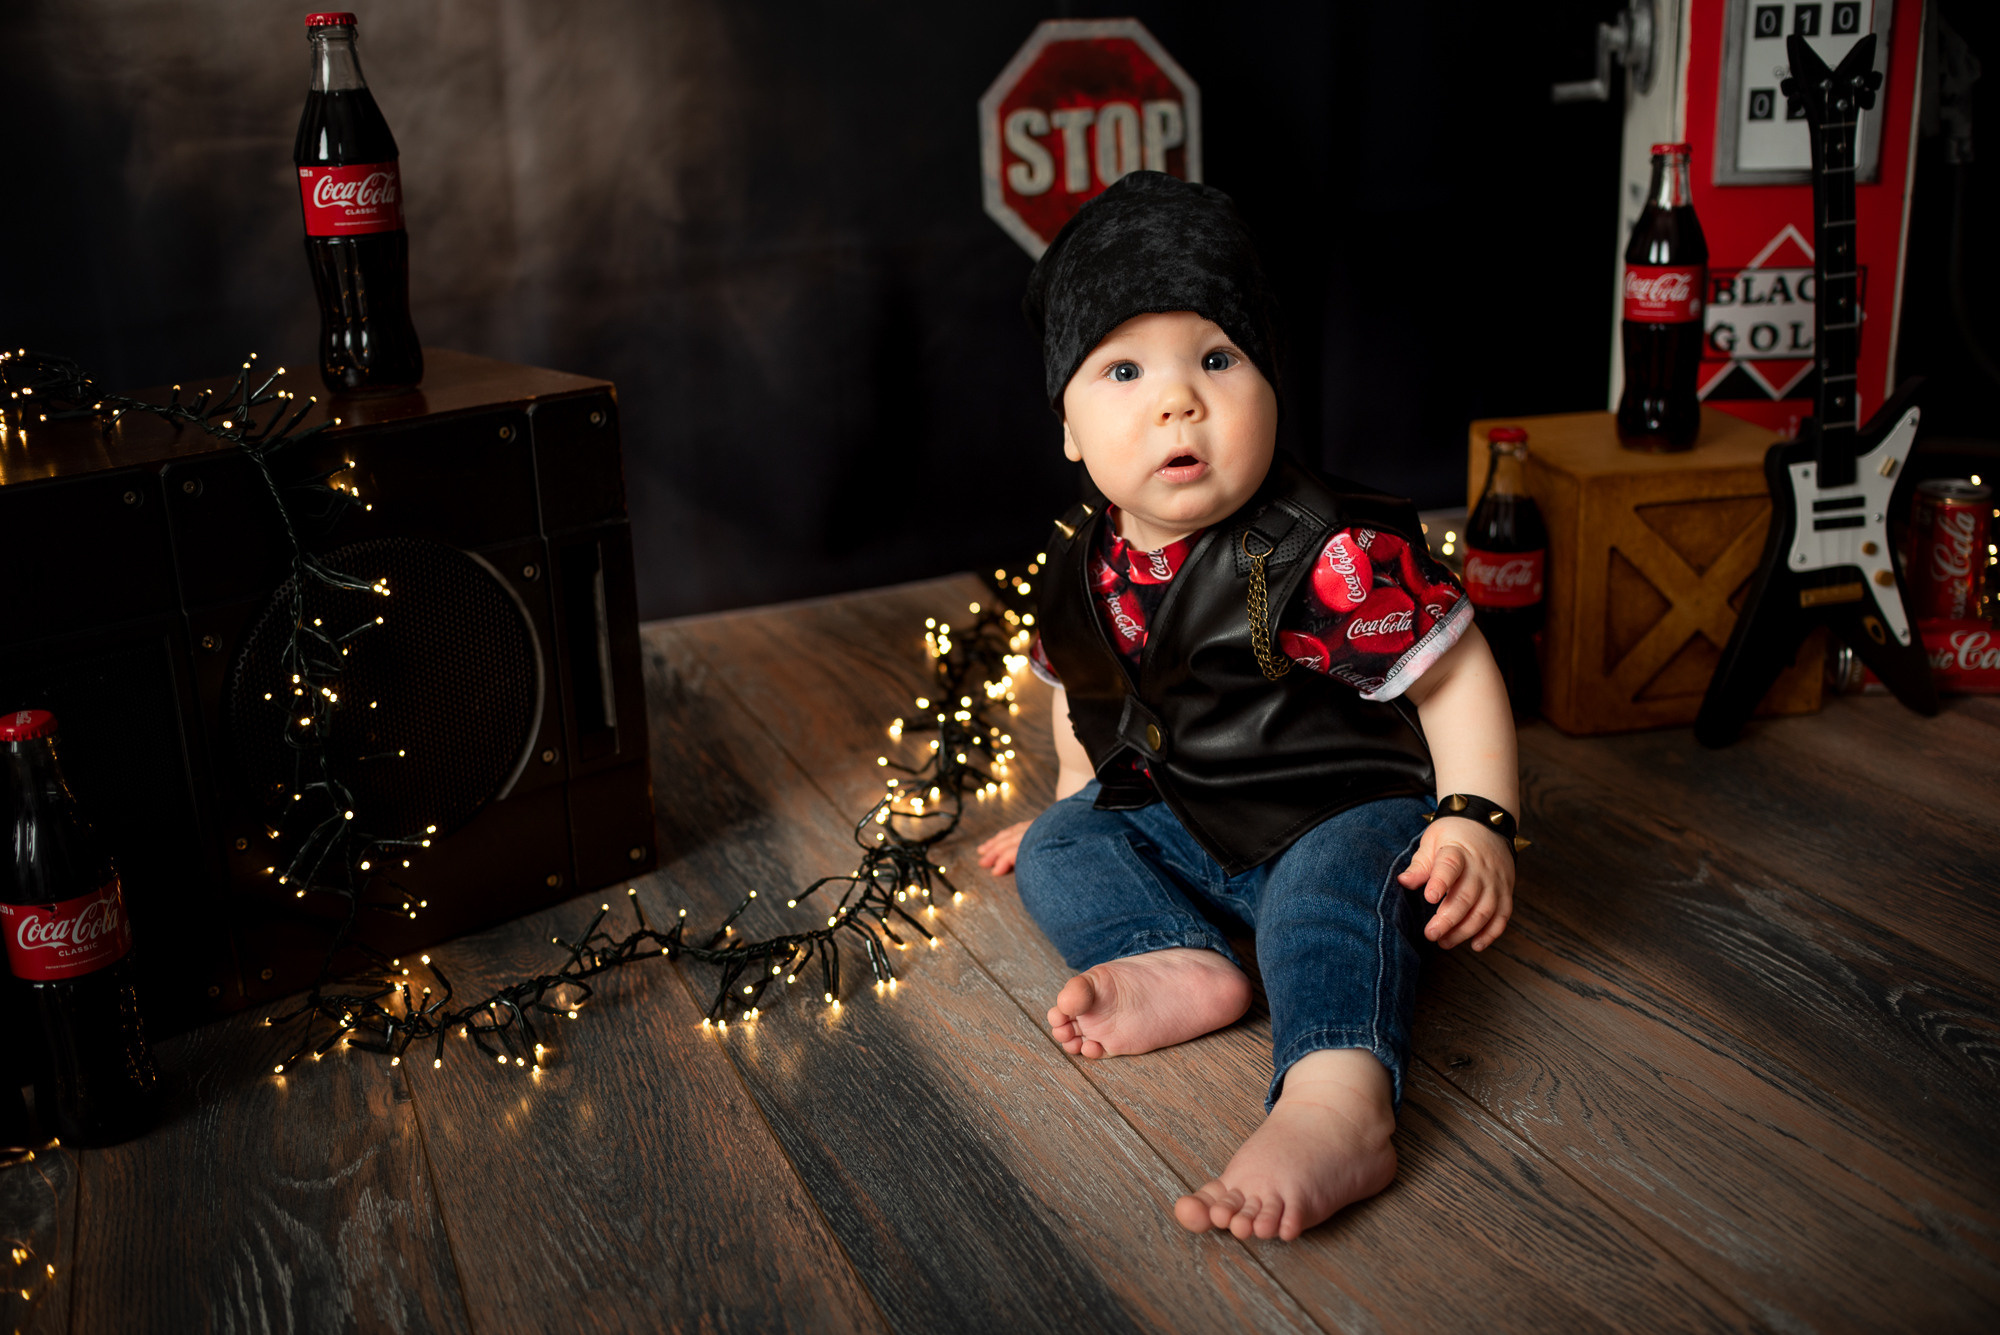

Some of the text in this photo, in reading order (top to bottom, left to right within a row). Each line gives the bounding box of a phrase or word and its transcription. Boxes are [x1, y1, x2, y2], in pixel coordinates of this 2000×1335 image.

[1004, 101, 1184, 196] STOP
[313, 171, 397, 208] Coca-Cola
[1712, 274, 1815, 306] BLAC
[1710, 322, 1815, 352] GOL
[1325, 537, 1367, 603] Coca-Cola
[1347, 610, 1414, 639] Coca-Cola
[17, 892, 119, 950] Coca-Cola
[58, 942, 99, 957] CLASSIC
